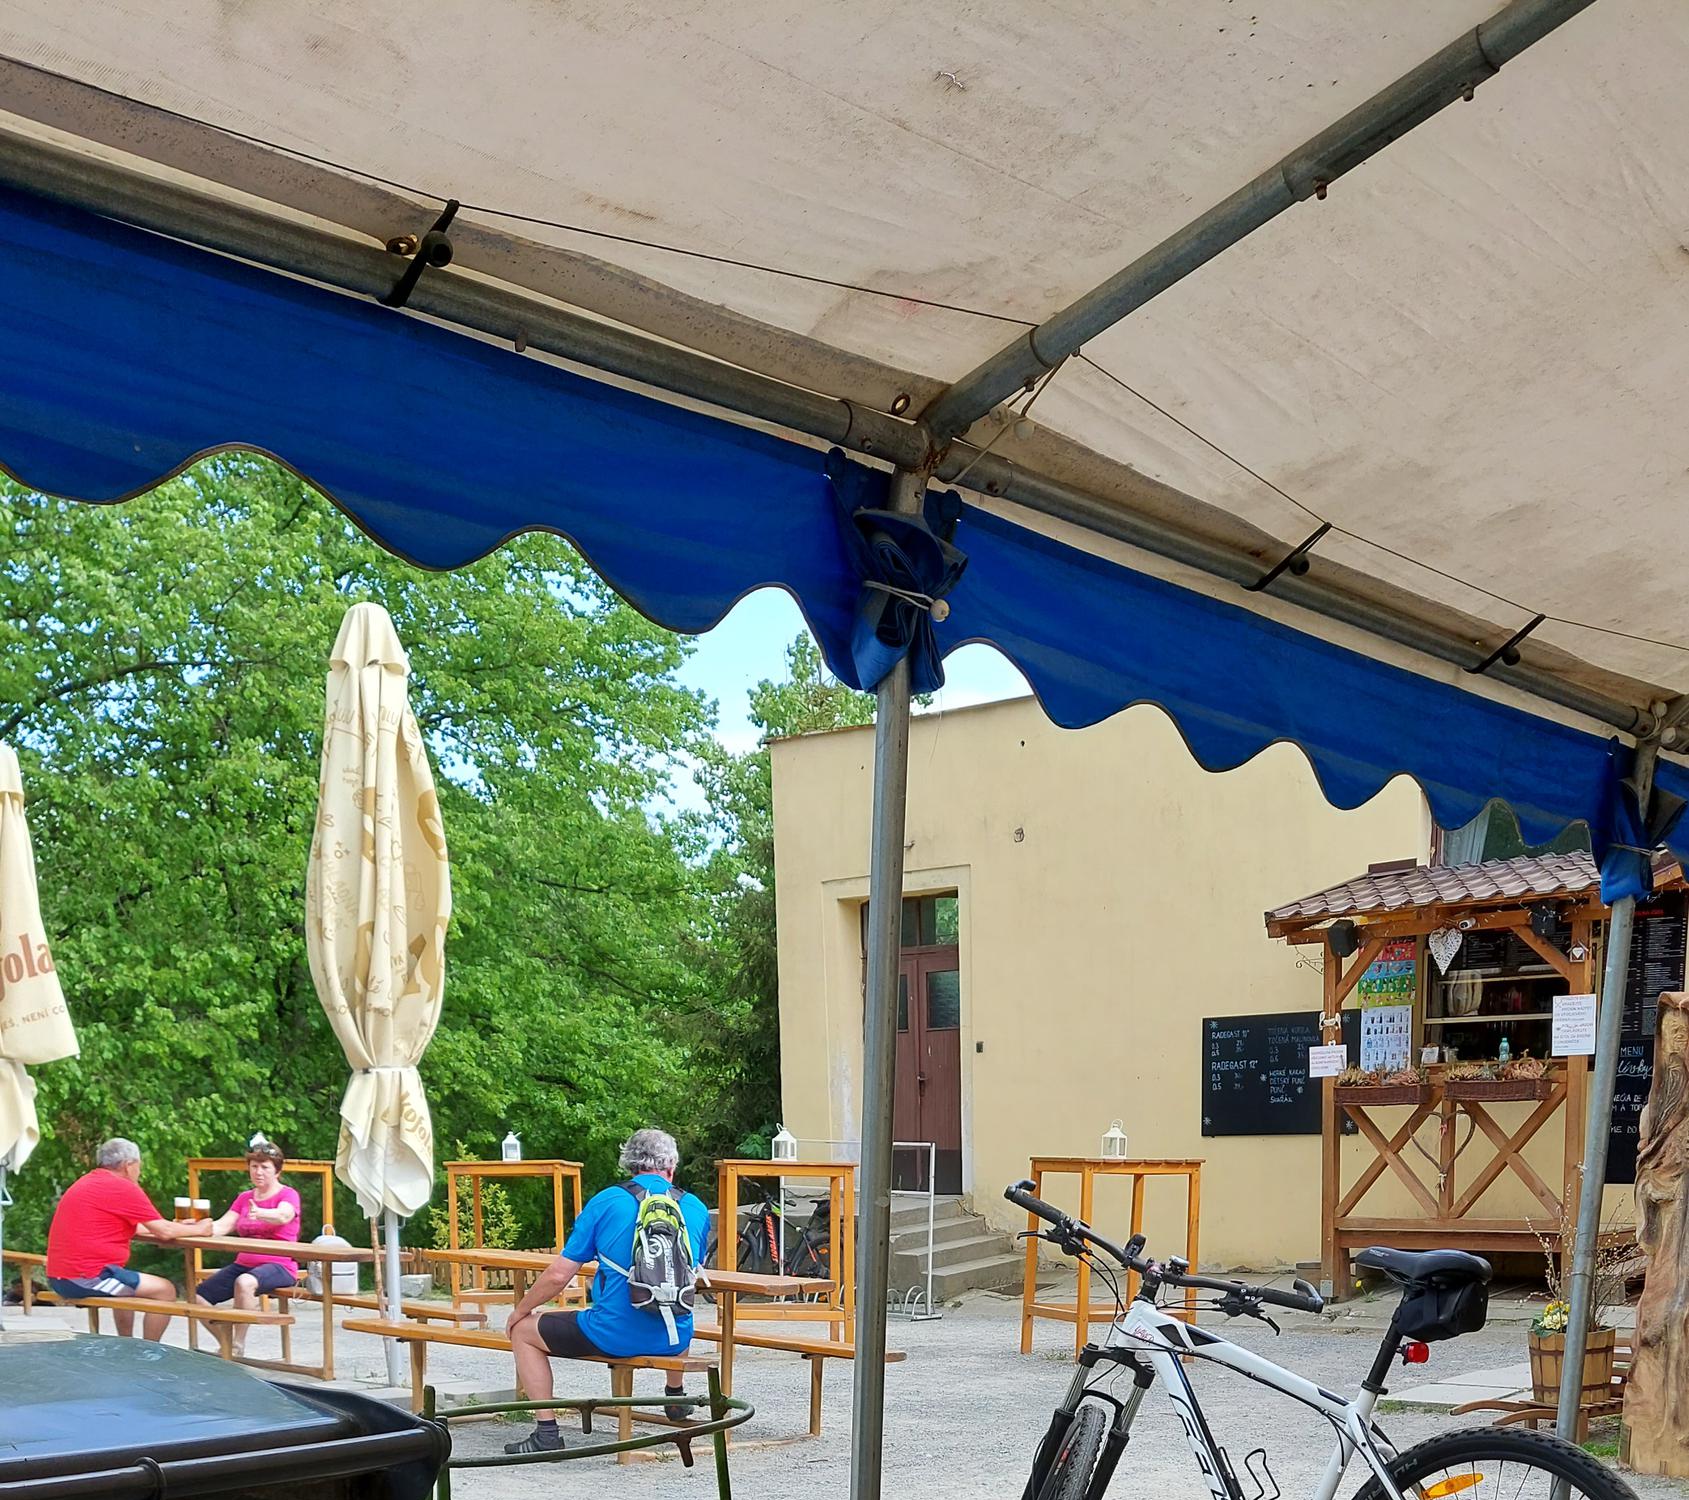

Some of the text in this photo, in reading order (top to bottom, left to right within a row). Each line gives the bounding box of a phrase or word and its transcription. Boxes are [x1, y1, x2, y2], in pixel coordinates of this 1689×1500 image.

[0, 933, 56, 1001] ola
[1212, 1031, 1240, 1039] RADEGAST
[1620, 1046, 1644, 1056] MENU
[1212, 1060, 1248, 1071] RADEGAST
[1616, 1059, 1653, 1080] lívky
